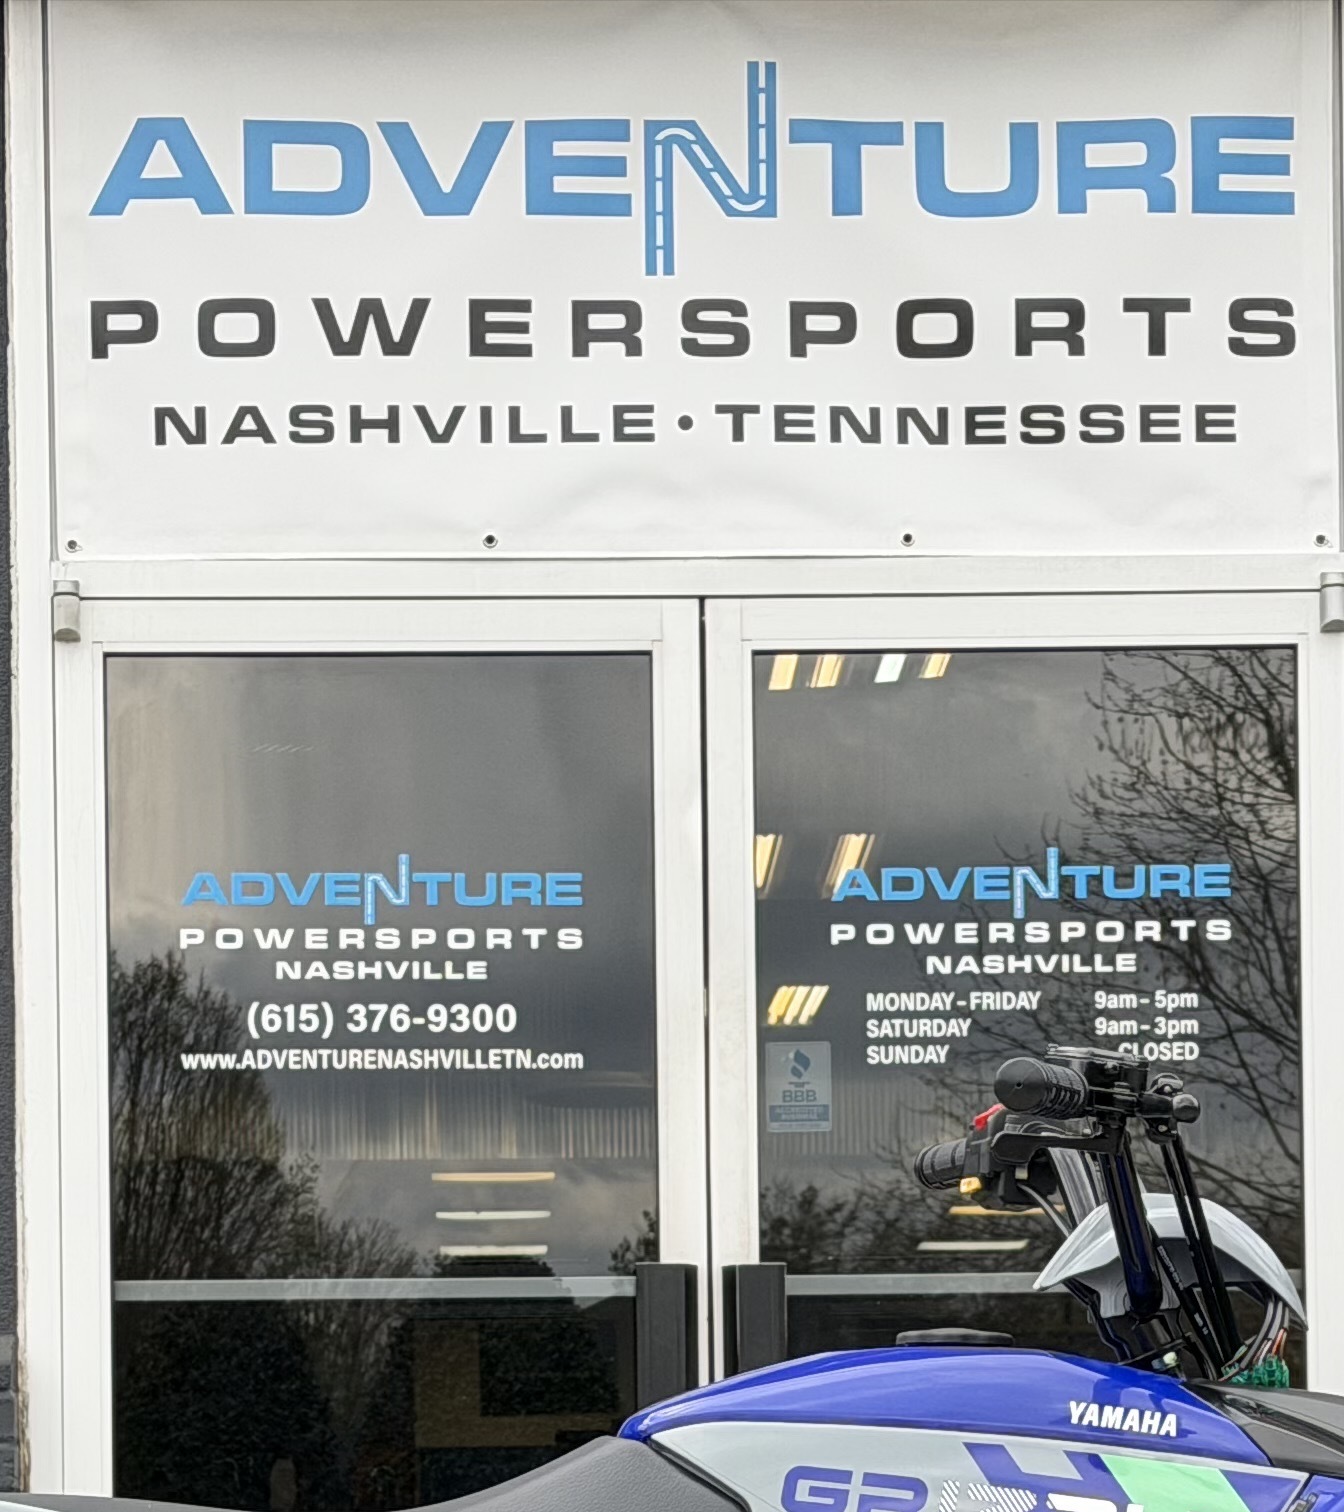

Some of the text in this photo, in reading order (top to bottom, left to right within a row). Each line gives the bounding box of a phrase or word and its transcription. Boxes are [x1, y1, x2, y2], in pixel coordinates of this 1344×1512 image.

[90, 60, 1296, 276] ADVENTURE
[90, 297, 1297, 360] POWERSPORTS
[154, 403, 1238, 446] NASHVILLE TENNESSEE
[181, 854, 584, 926] ADVENTURE
[830, 846, 1233, 919] ADVENTURE
[179, 927, 584, 950] POWERSPORTS
[830, 919, 1233, 946] POWERSPORTS
[274, 960, 489, 981] NASHVILLE
[925, 952, 1138, 975] NASHVILLE
[247, 1001, 517, 1040] (615) 376-9300
[866, 1017, 972, 1039] SATURDAY
[180, 1048, 584, 1070] www.ADVENTURENASHVILLETN.com
[866, 1044, 950, 1065] SUNDAY
[782, 1088, 817, 1104] BBB
[1069, 1400, 1177, 1438] YAMAHA
